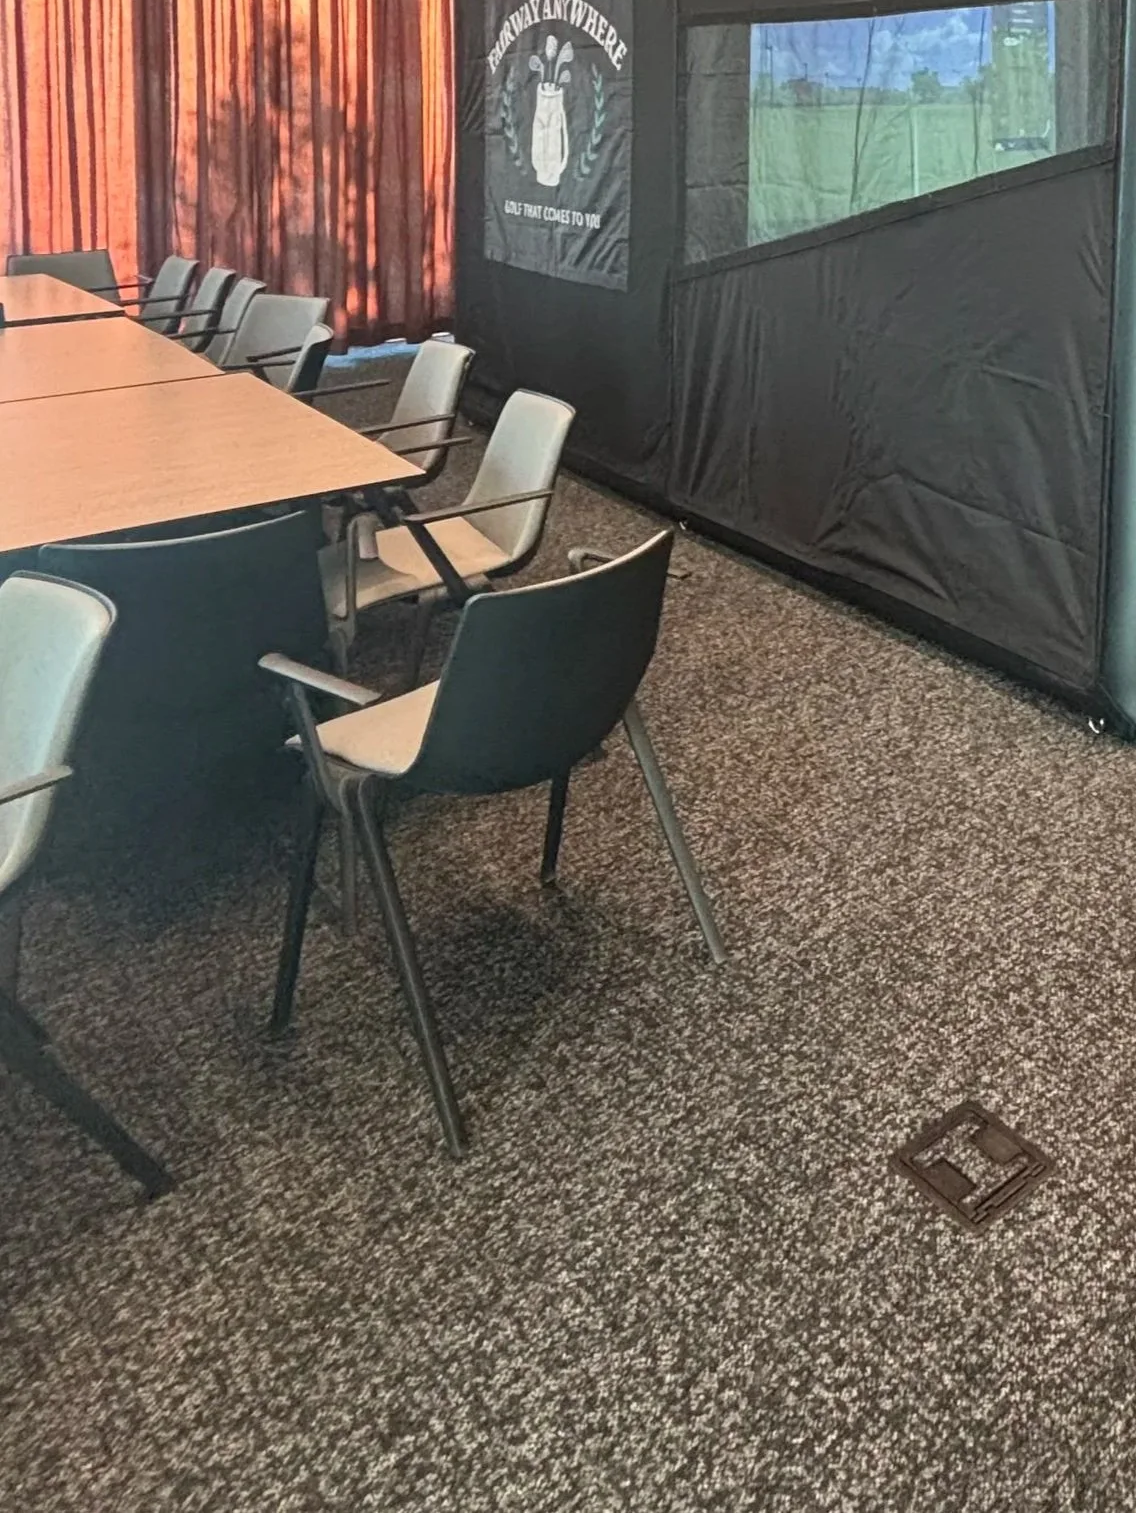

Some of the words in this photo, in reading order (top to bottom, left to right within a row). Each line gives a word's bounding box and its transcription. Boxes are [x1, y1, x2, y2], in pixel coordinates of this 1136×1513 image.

[504, 199, 522, 216] GOLF
[523, 202, 542, 219] THAT
[543, 205, 570, 224] COMES
[571, 210, 584, 226] TO
[585, 212, 601, 229] YOU
